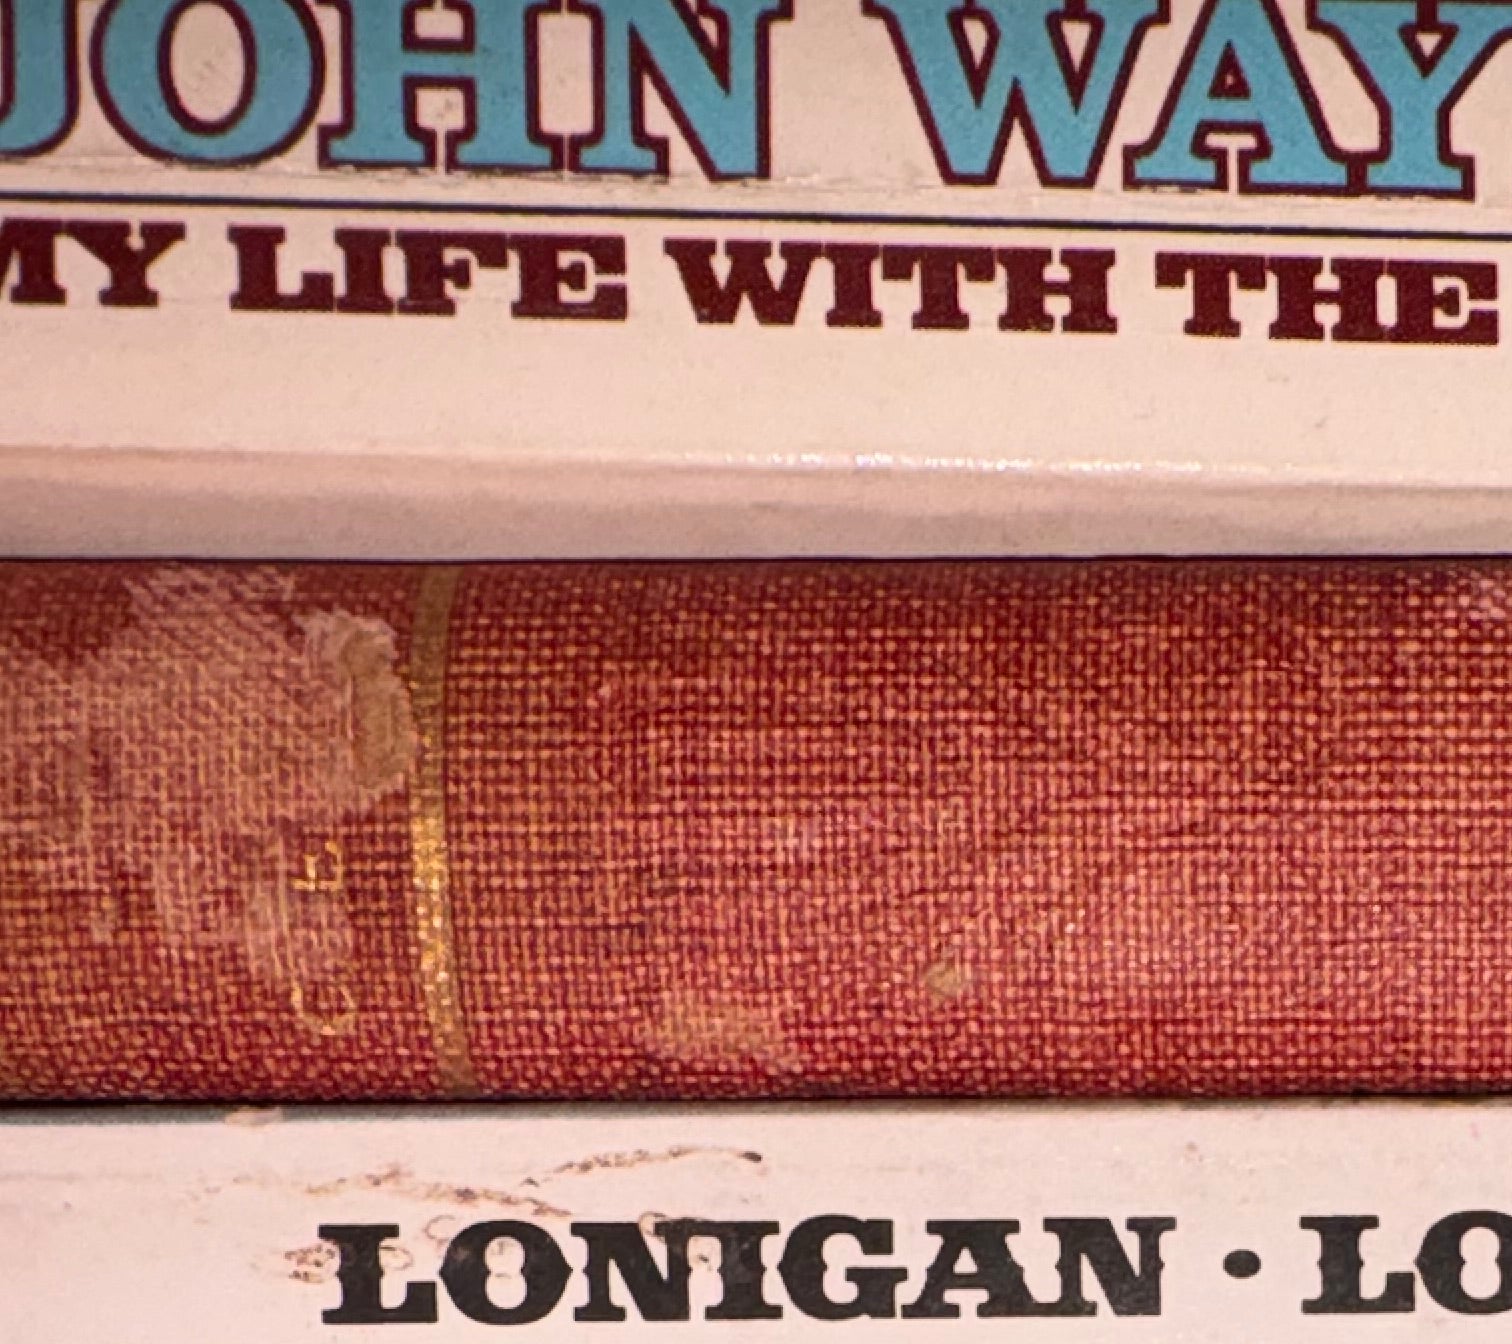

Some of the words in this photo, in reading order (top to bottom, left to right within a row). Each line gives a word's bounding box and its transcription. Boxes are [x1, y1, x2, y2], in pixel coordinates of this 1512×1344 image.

[0, 0, 795, 180] JOHN
[228, 225, 628, 320] LIFE
[663, 237, 1117, 333] WITH
[1155, 251, 1499, 346] THE
[318, 1214, 1176, 1325] LONIGAN
